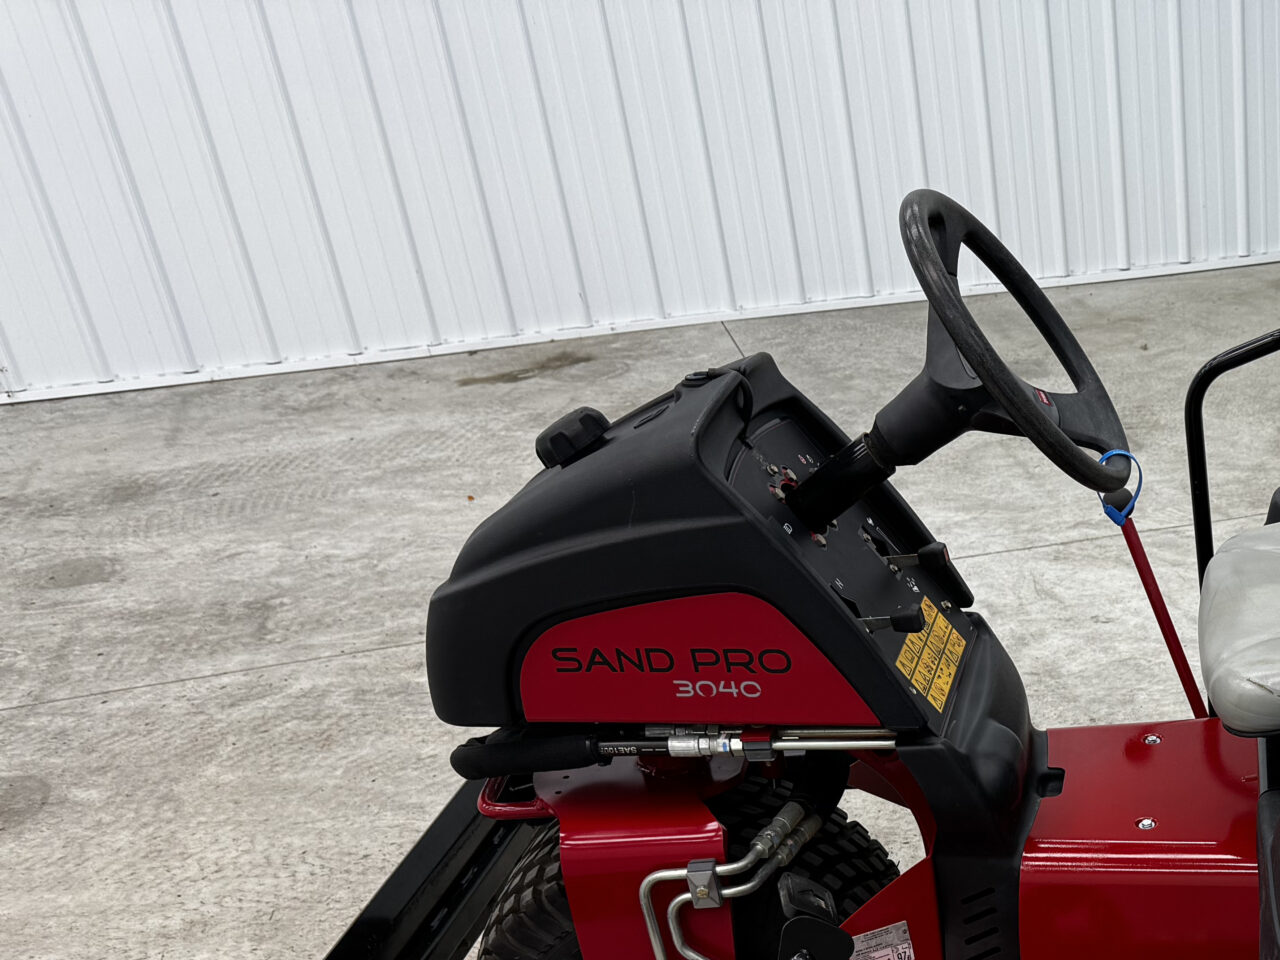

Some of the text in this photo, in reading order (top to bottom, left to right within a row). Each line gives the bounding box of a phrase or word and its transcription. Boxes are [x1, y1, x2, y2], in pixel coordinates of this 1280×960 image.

[552, 648, 792, 674] SAND PRO
[673, 680, 762, 698] 3040
